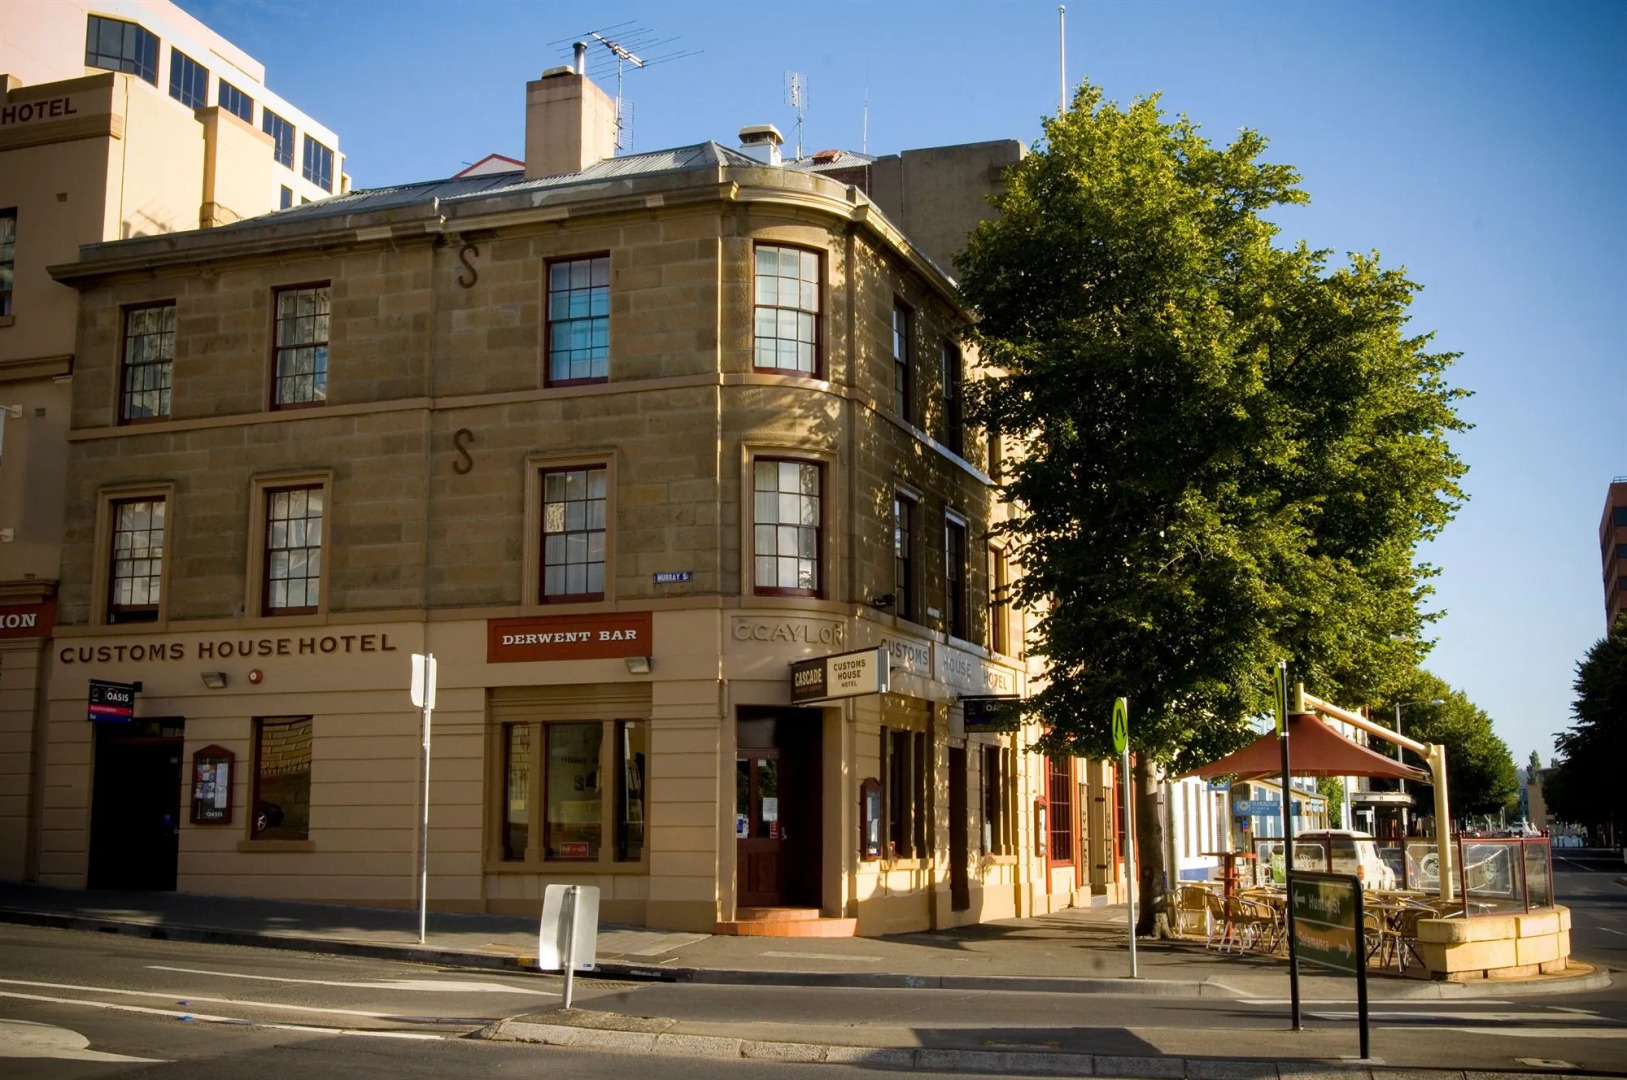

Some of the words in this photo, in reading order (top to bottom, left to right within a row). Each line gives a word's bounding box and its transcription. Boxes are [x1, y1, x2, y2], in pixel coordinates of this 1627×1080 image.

[2, 97, 77, 125] HOTEL
[657, 573, 681, 581] MURRAY
[502, 631, 590, 645] DERWENT
[599, 629, 637, 641] BAR
[60, 643, 185, 664] CUSTOMS
[198, 638, 292, 660] HOUSE
[299, 633, 398, 655] HOTEL
[833, 659, 866, 671] CUSTOMS
[795, 667, 823, 687] CASCADE
[837, 671, 861, 681] HOUSE
[943, 655, 972, 678] HOUSE
[983, 669, 1008, 690] HOTEL
[841, 680, 857, 688] HOTEL
[107, 692, 129, 702] OASIS
